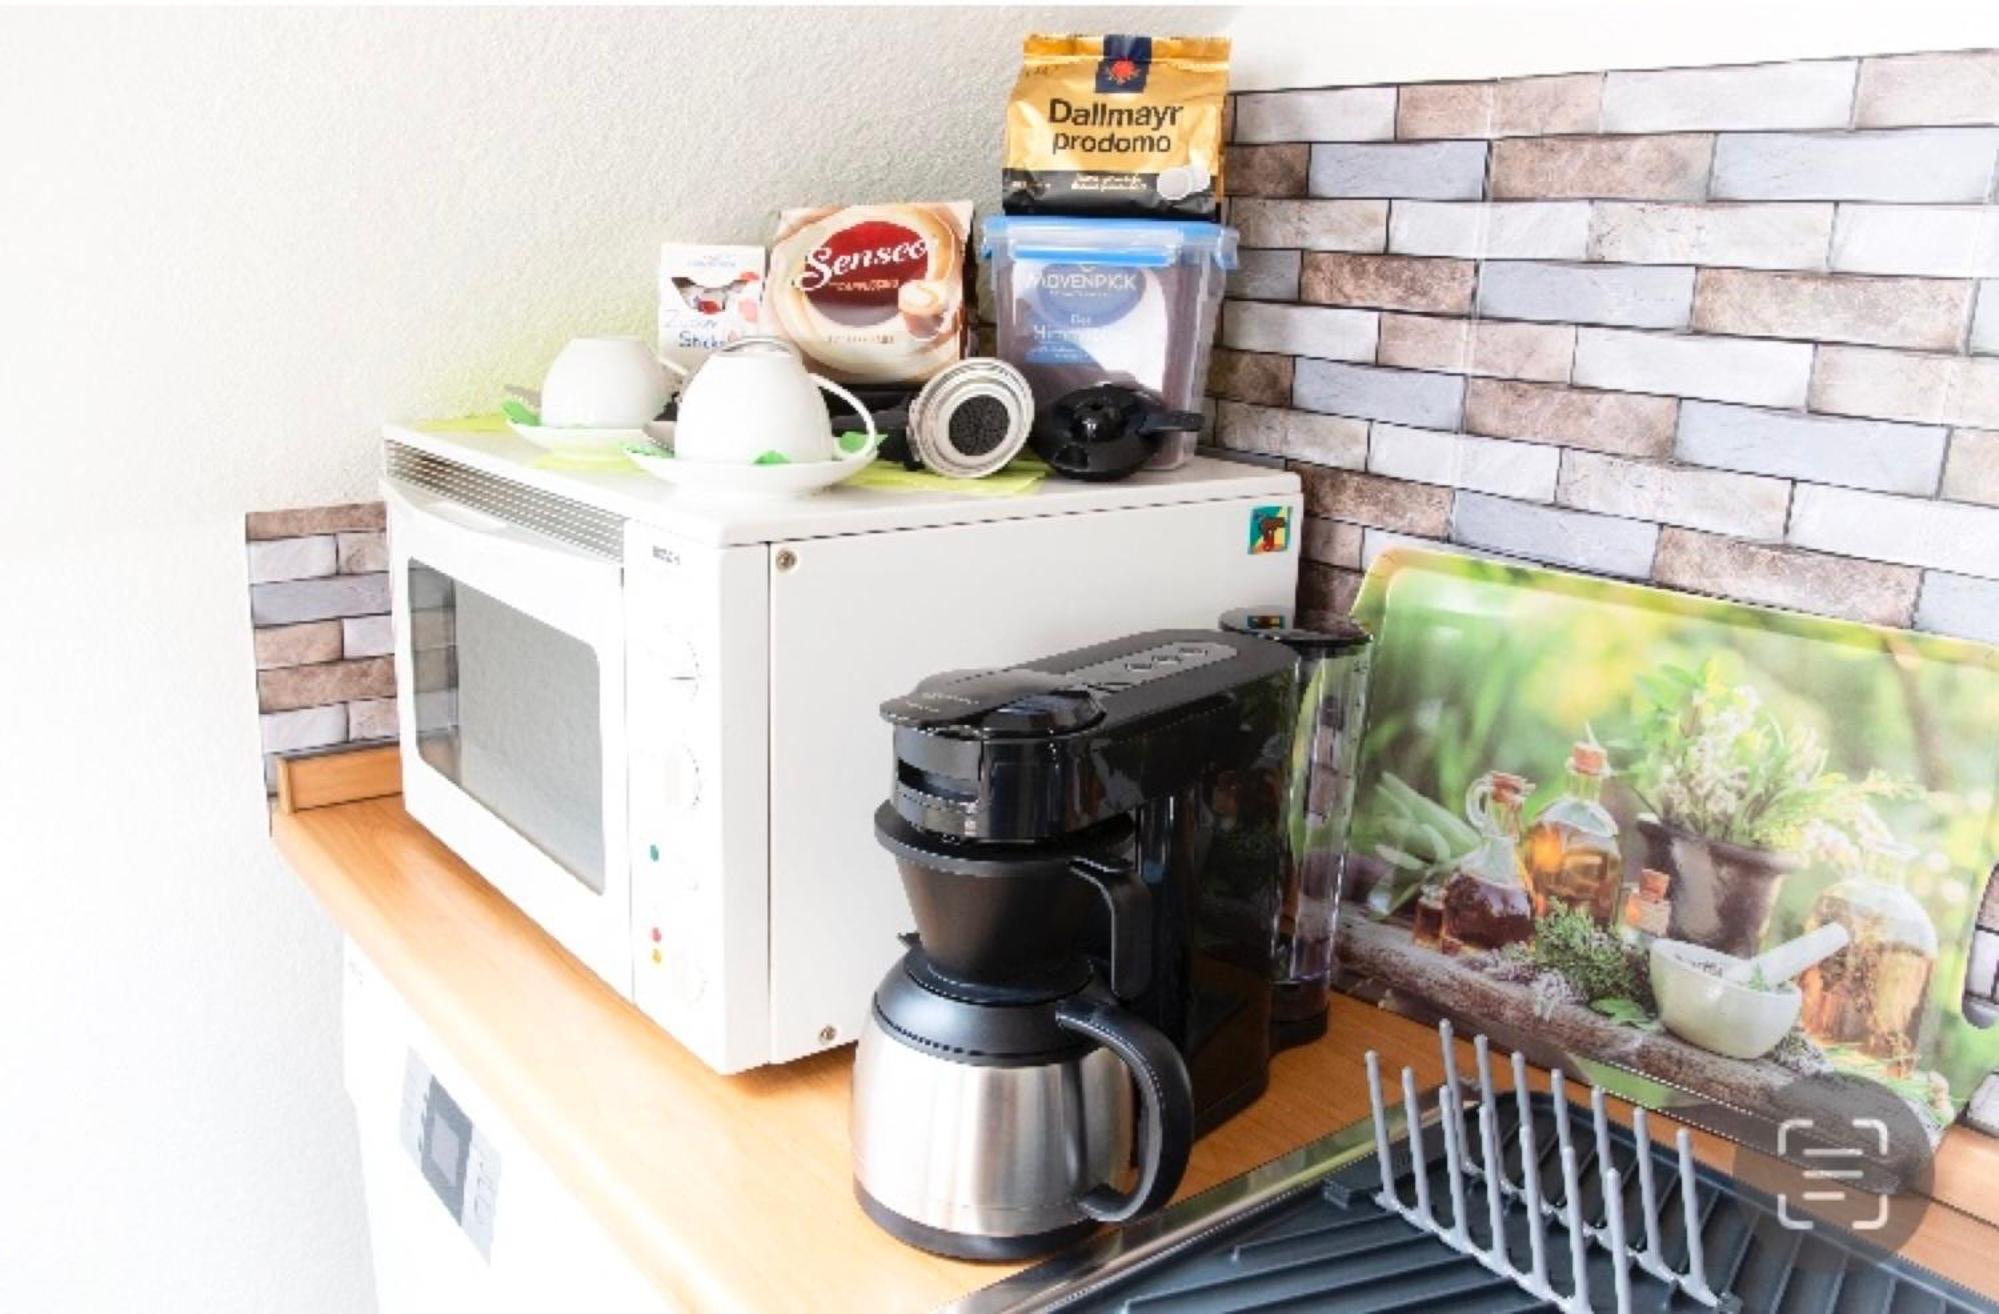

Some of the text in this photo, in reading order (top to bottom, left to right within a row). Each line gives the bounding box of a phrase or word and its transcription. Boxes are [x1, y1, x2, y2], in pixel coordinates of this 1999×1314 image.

[1050, 98, 1184, 131] Dallmayr
[1053, 132, 1171, 154] prodomo
[798, 239, 928, 291] Senseo
